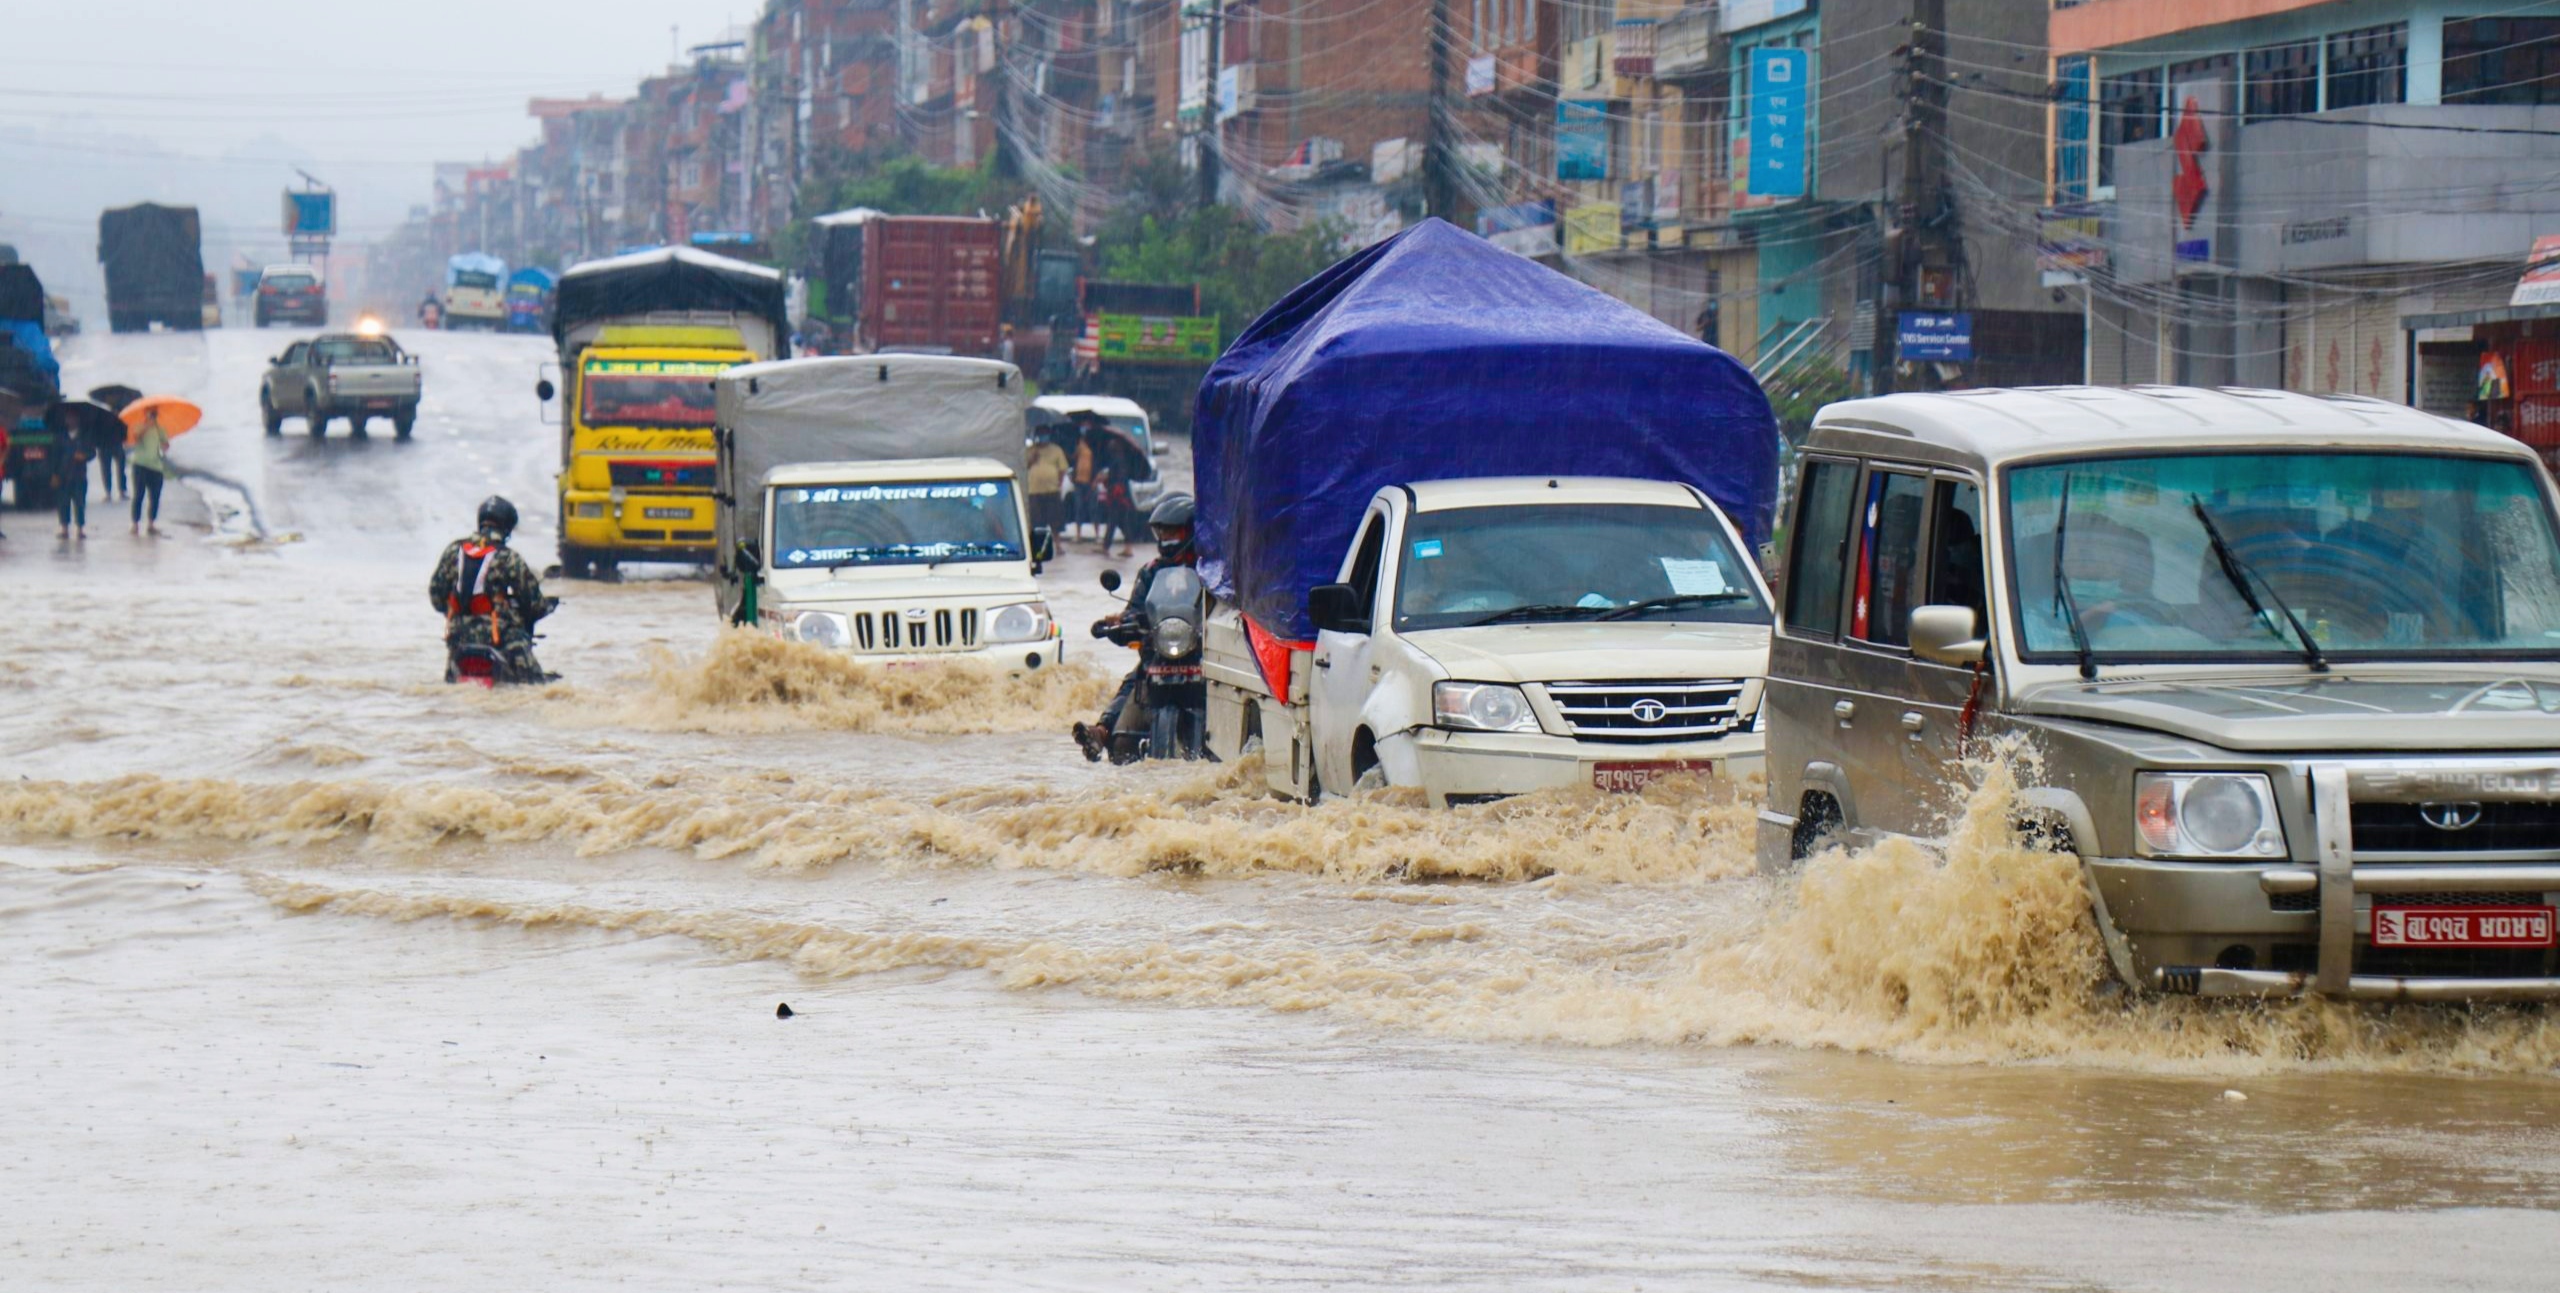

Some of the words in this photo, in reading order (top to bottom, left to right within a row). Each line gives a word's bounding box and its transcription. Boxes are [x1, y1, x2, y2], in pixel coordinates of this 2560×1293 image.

[1917, 333, 1945, 344] Service
[1946, 333, 1970, 344] Center
[812, 488, 840, 503] श्री
